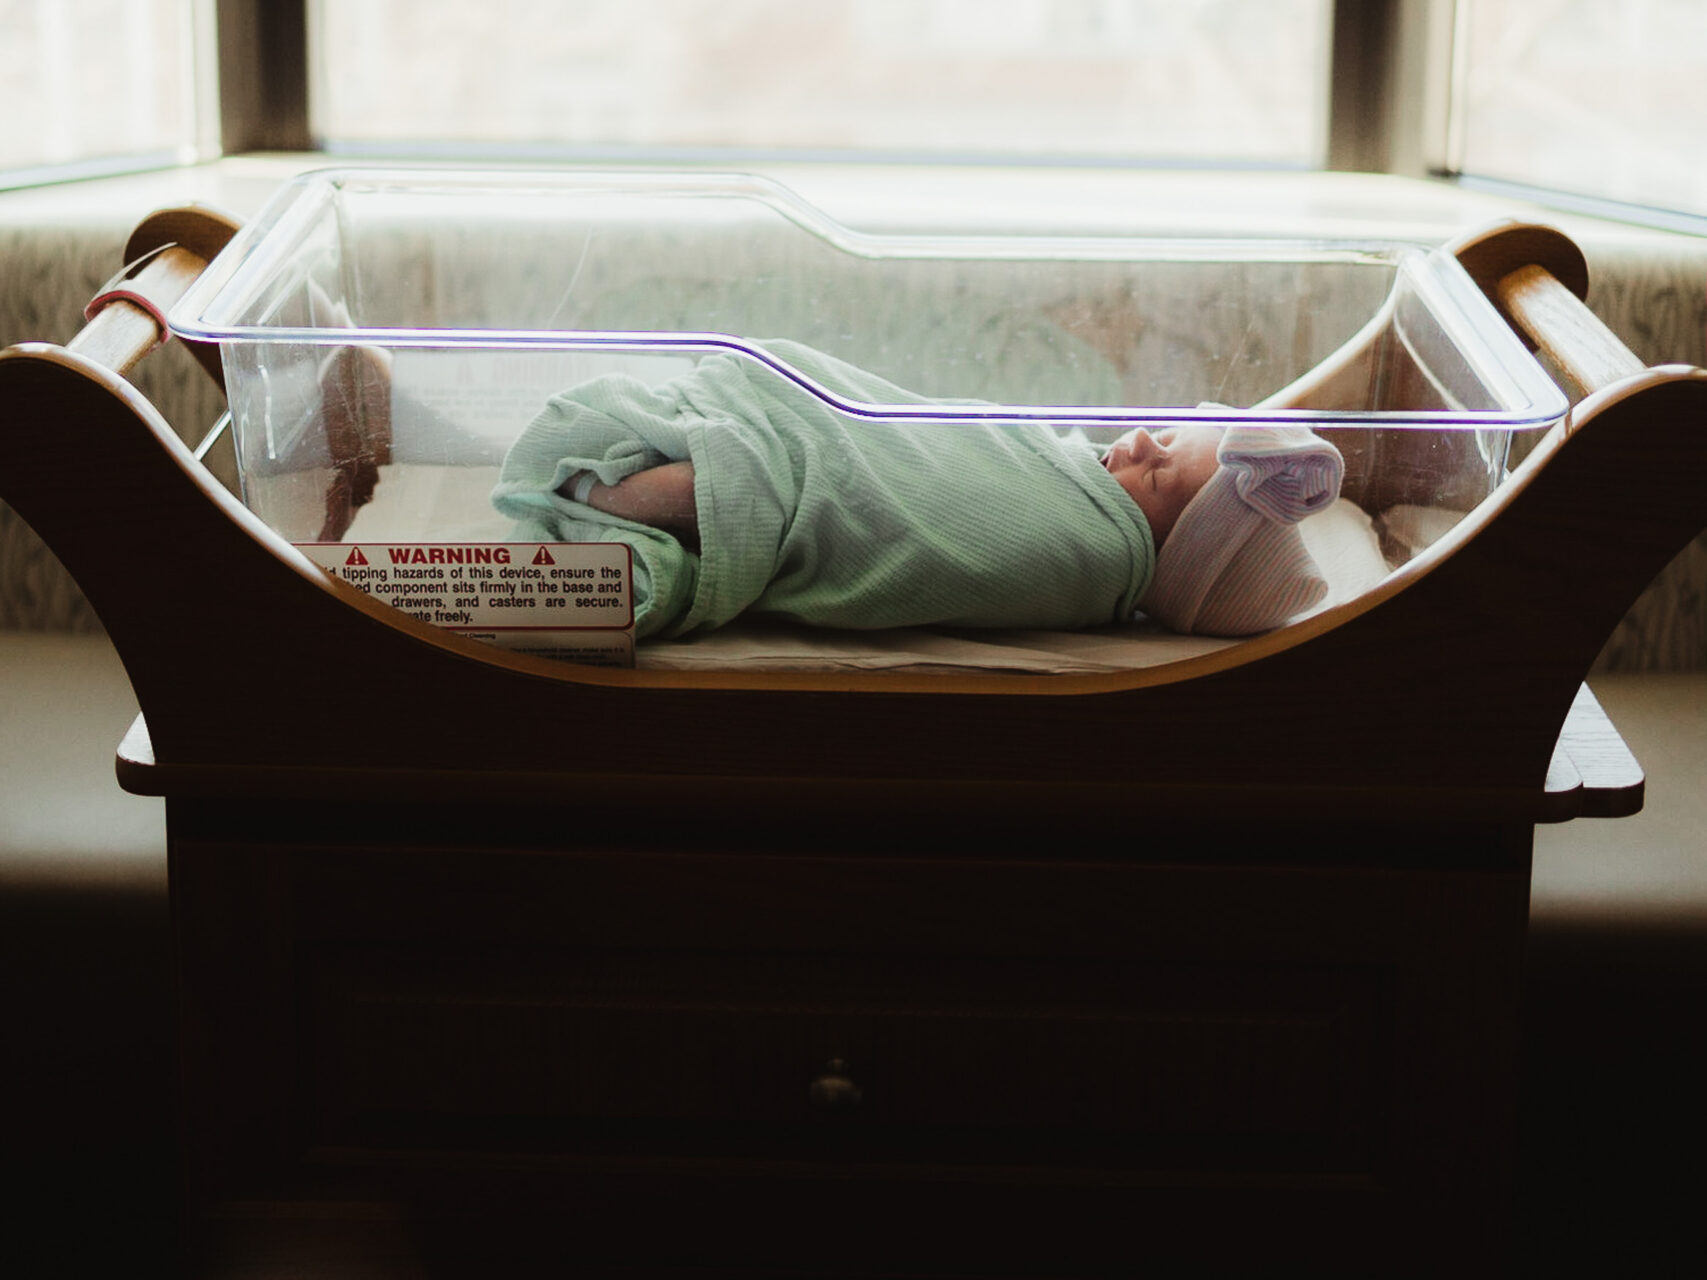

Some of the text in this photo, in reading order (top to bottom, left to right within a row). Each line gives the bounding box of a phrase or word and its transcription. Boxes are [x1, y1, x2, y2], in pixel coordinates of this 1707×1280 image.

[388, 548, 511, 564] WARNING
[342, 567, 388, 581] tipping
[393, 567, 444, 579] hazards
[450, 567, 463, 579] of
[469, 567, 493, 579] this
[499, 567, 545, 580] device,
[550, 570, 595, 579] ensure
[601, 567, 621, 579] the
[375, 582, 447, 595] component
[452, 582, 475, 593] sits
[480, 581, 516, 595] firmly
[521, 582, 533, 593] in
[537, 582, 558, 593] the
[562, 582, 593, 593] base
[598, 582, 622, 593] and
[392, 596, 623, 609] drawers, and casters are secure.
[435, 610, 473, 624] freely.
